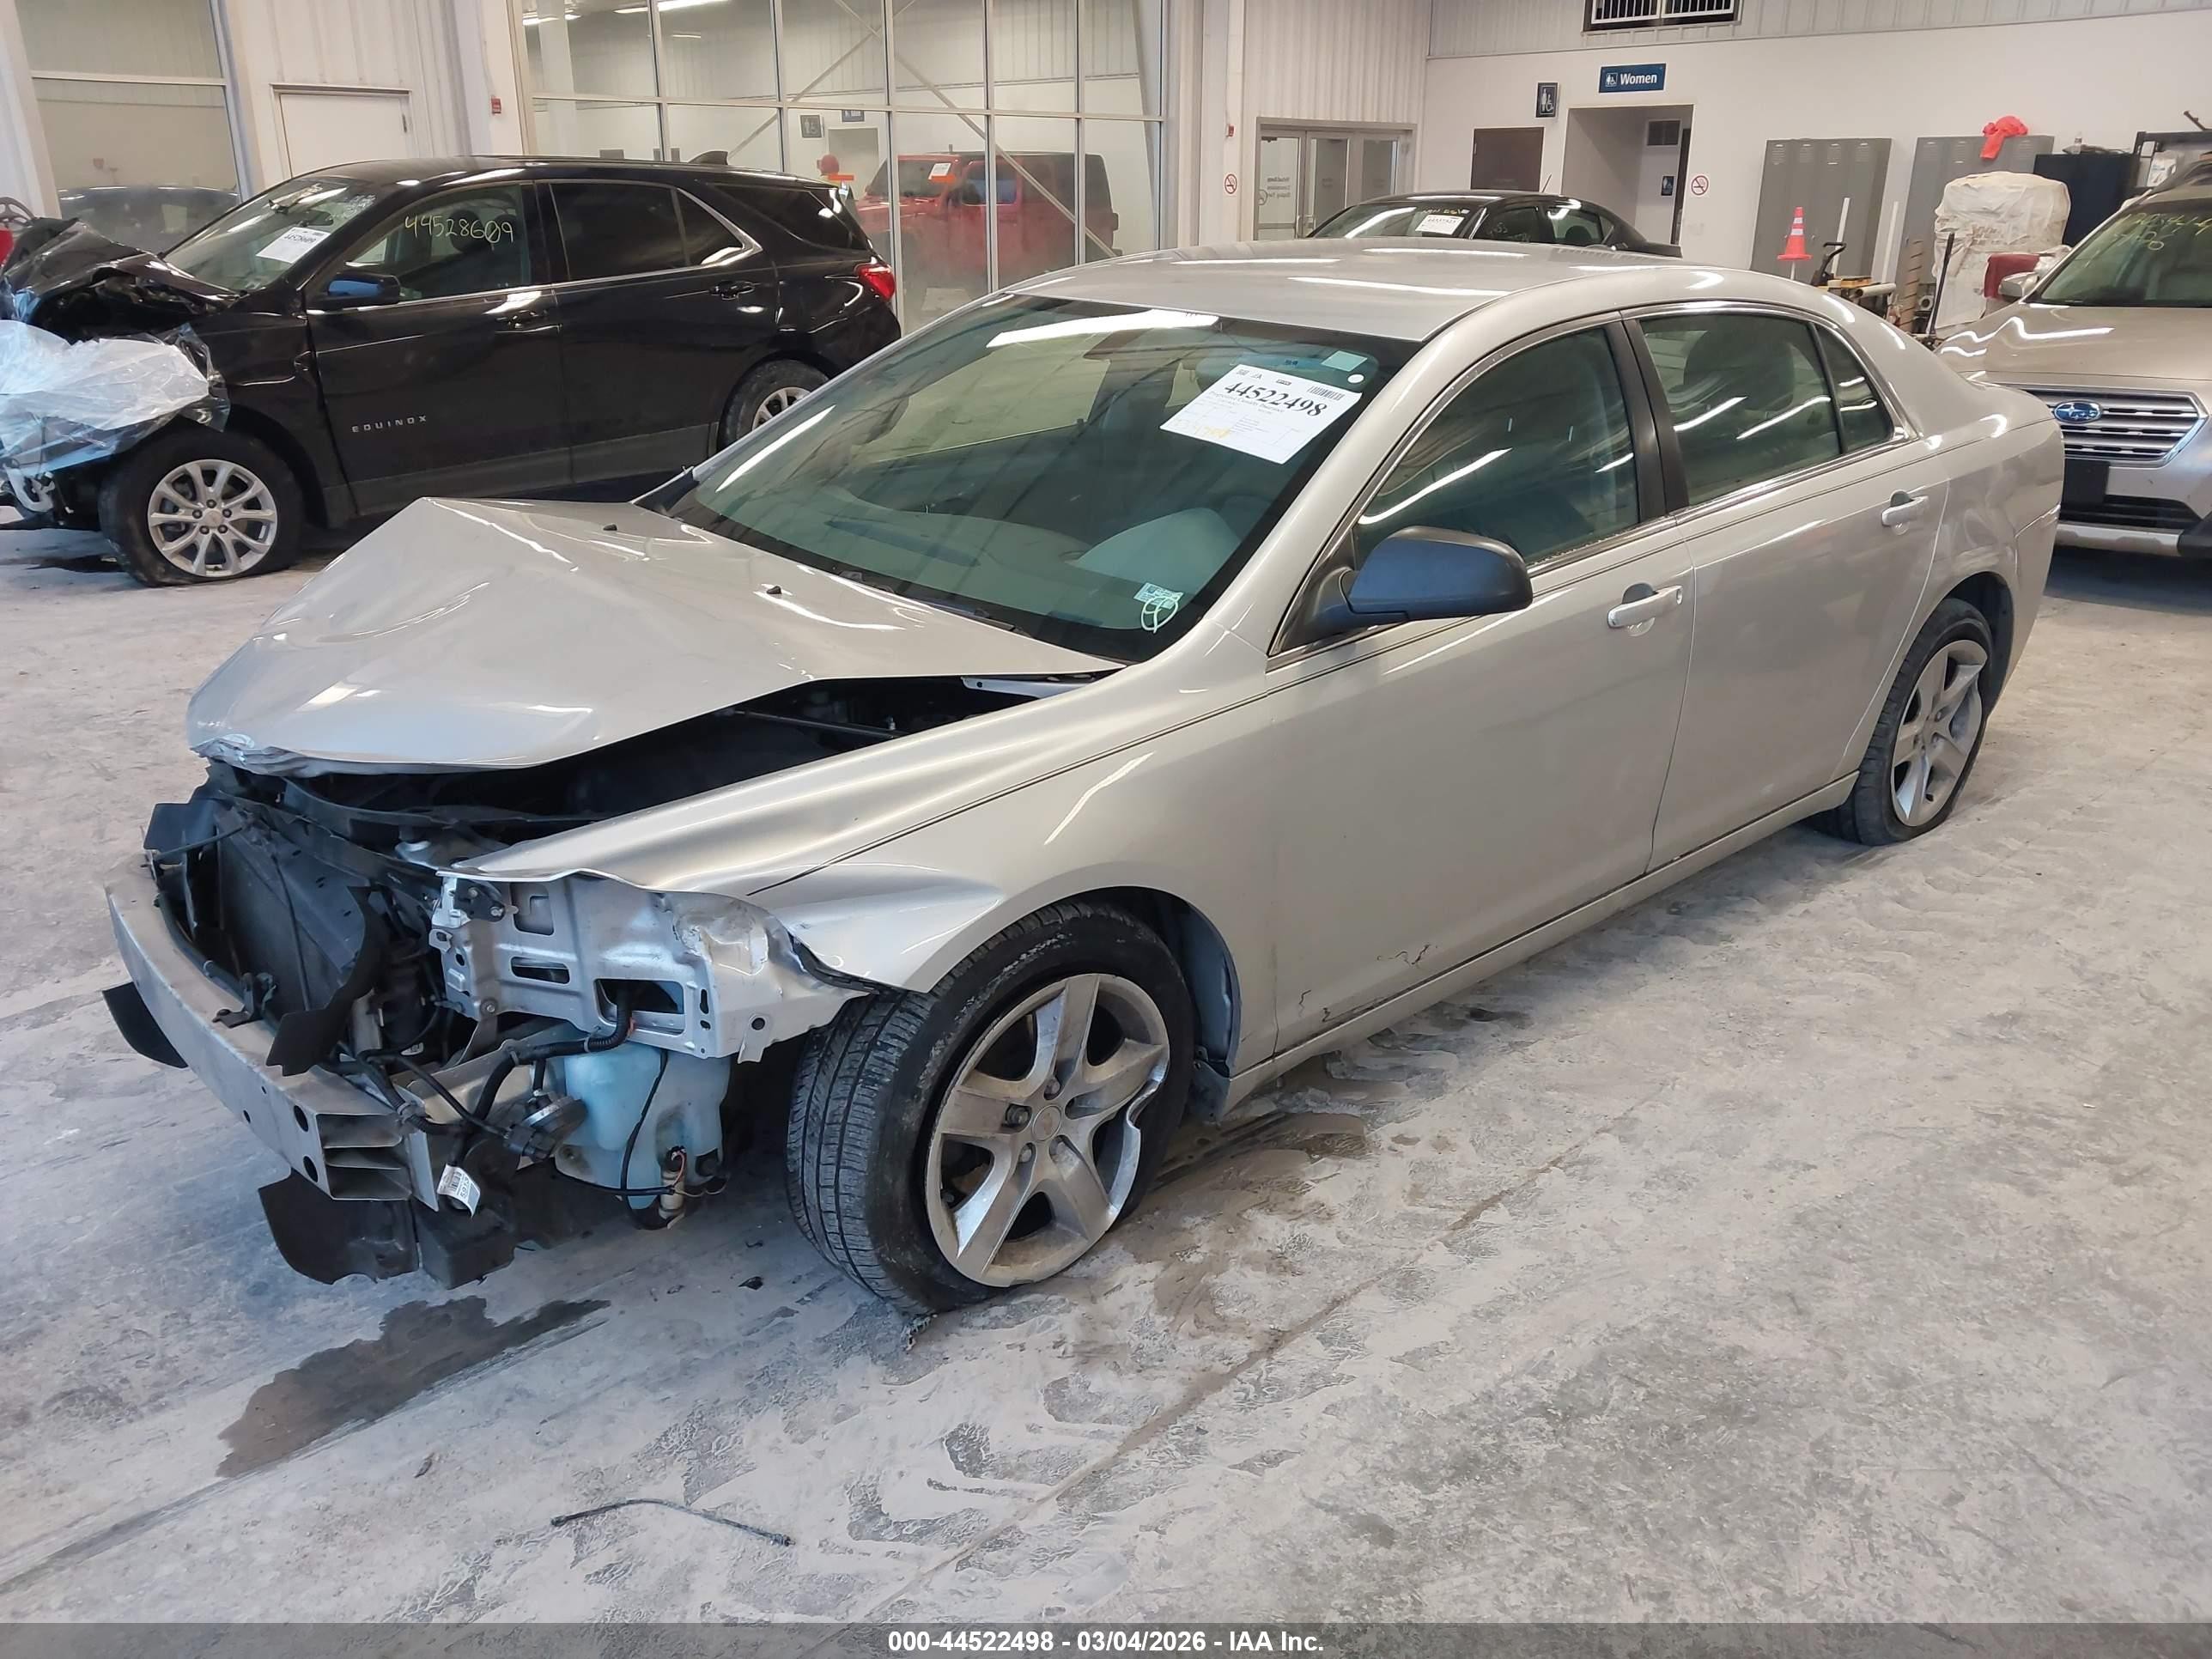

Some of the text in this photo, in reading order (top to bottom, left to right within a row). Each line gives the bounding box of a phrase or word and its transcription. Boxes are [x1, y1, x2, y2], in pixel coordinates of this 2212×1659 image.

[1620, 73, 1657, 85] Women
[404, 215, 514, 244] 44528609
[1224, 381, 1328, 416] 44522498
[351, 415, 427, 433] EQUINOX
